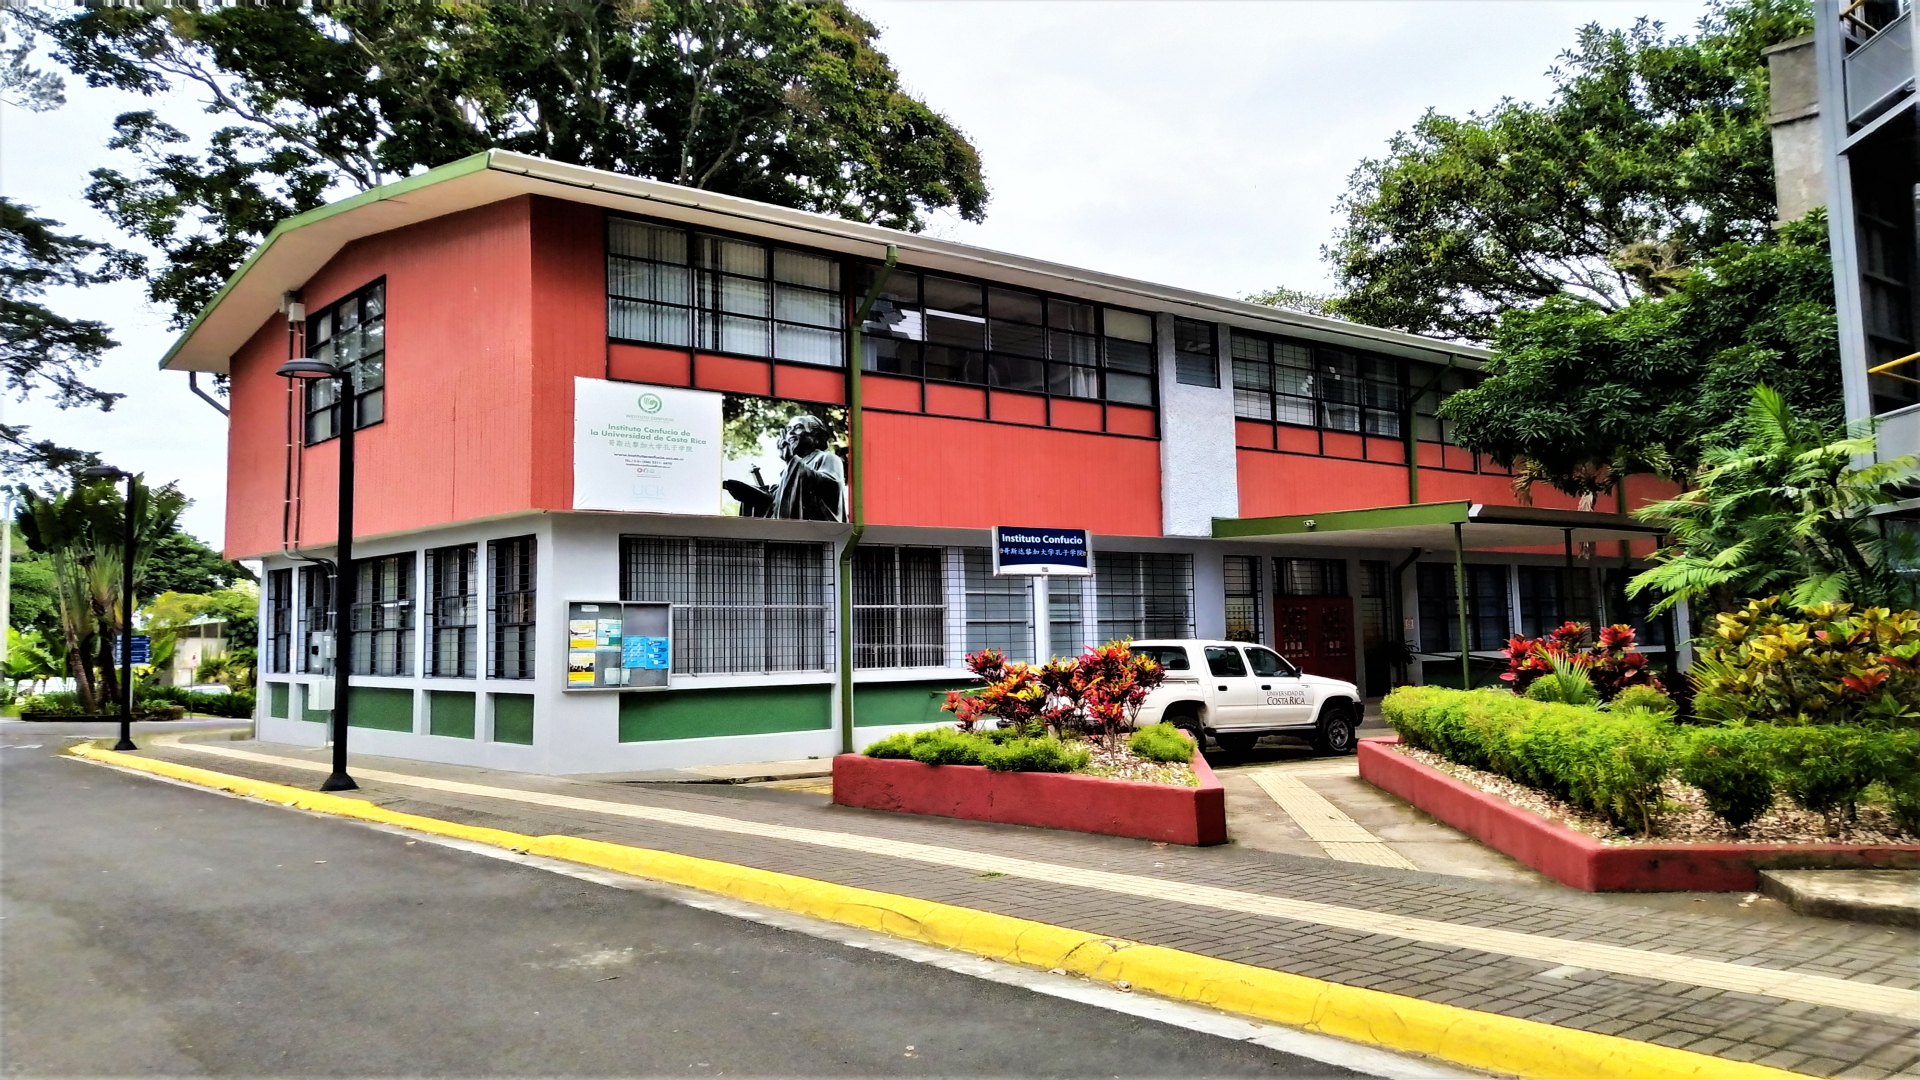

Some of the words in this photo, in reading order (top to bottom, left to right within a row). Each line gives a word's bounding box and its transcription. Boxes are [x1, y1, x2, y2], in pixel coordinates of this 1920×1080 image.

[608, 423, 642, 433] Instituto
[643, 426, 679, 436] Confucio
[681, 429, 691, 437] de
[601, 430, 652, 441] Universidad
[653, 433, 664, 441] de
[666, 435, 688, 444] Costa
[690, 437, 707, 445] Rica
[632, 483, 666, 497] UCR
[1002, 533, 1041, 543] Instituto
[1042, 535, 1083, 545] Confucio
[1266, 696, 1289, 705] COSTA
[1289, 696, 1306, 705] RICA
